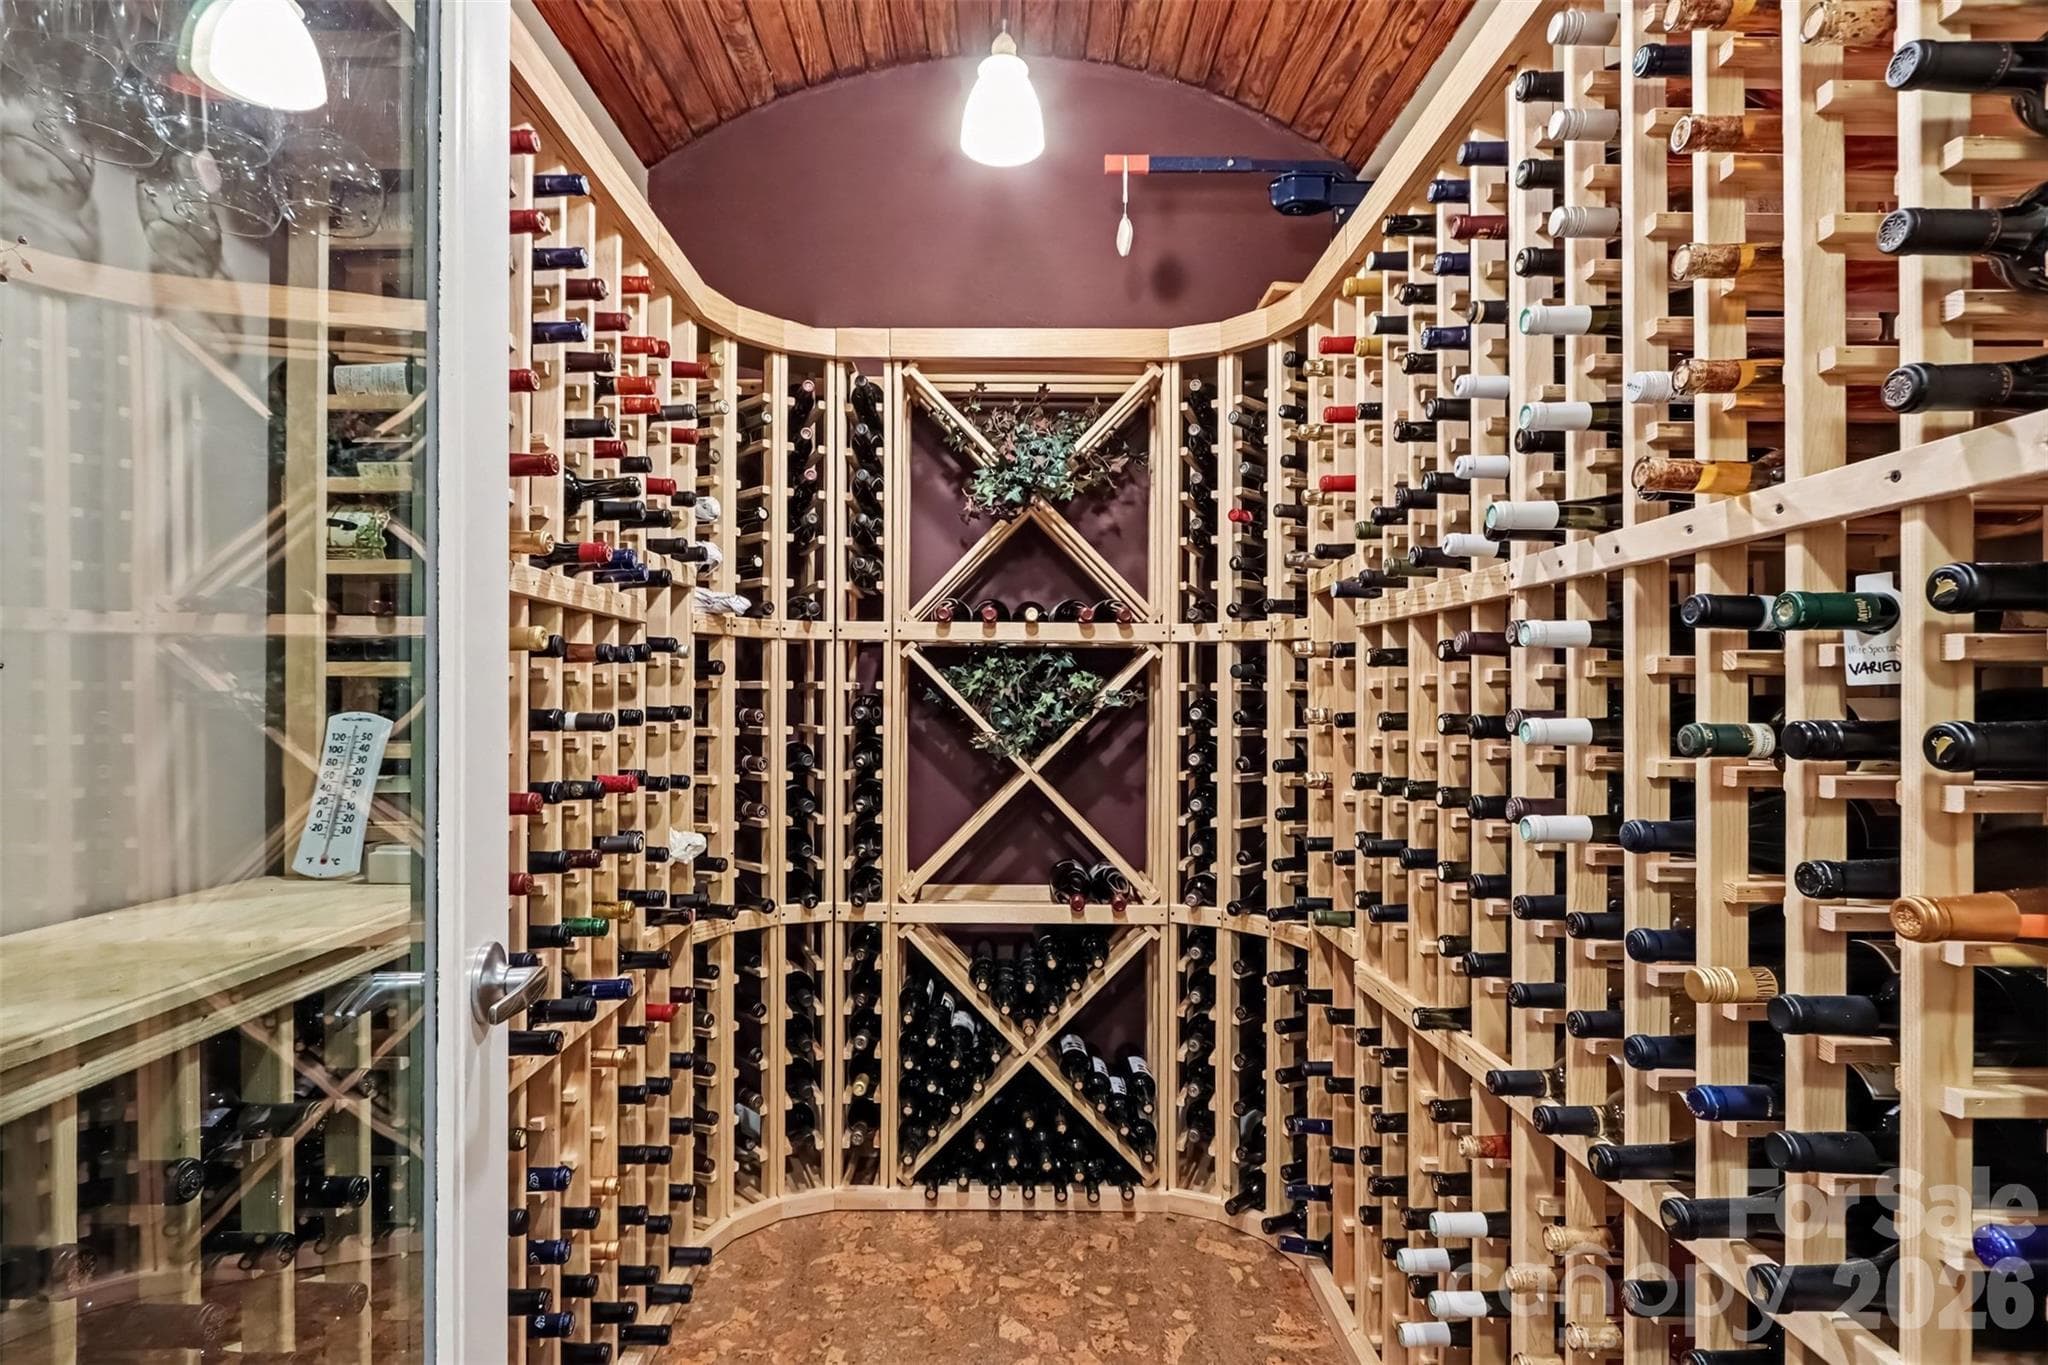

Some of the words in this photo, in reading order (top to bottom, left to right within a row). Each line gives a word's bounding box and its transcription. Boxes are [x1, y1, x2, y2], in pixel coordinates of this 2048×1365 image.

[1848, 660, 1901, 675] VARIED
[332, 732, 346, 741] 120
[361, 732, 373, 741] 50
[328, 745, 343, 754] 100
[359, 744, 370, 752] 40
[325, 758, 338, 766] 80
[356, 755, 367, 764] 30
[322, 771, 335, 779] 60
[353, 767, 365, 775] 20
[352, 779, 362, 787] 10
[320, 784, 331, 792] 40
[317, 797, 329, 805] 20
[316, 810, 323, 818] 0
